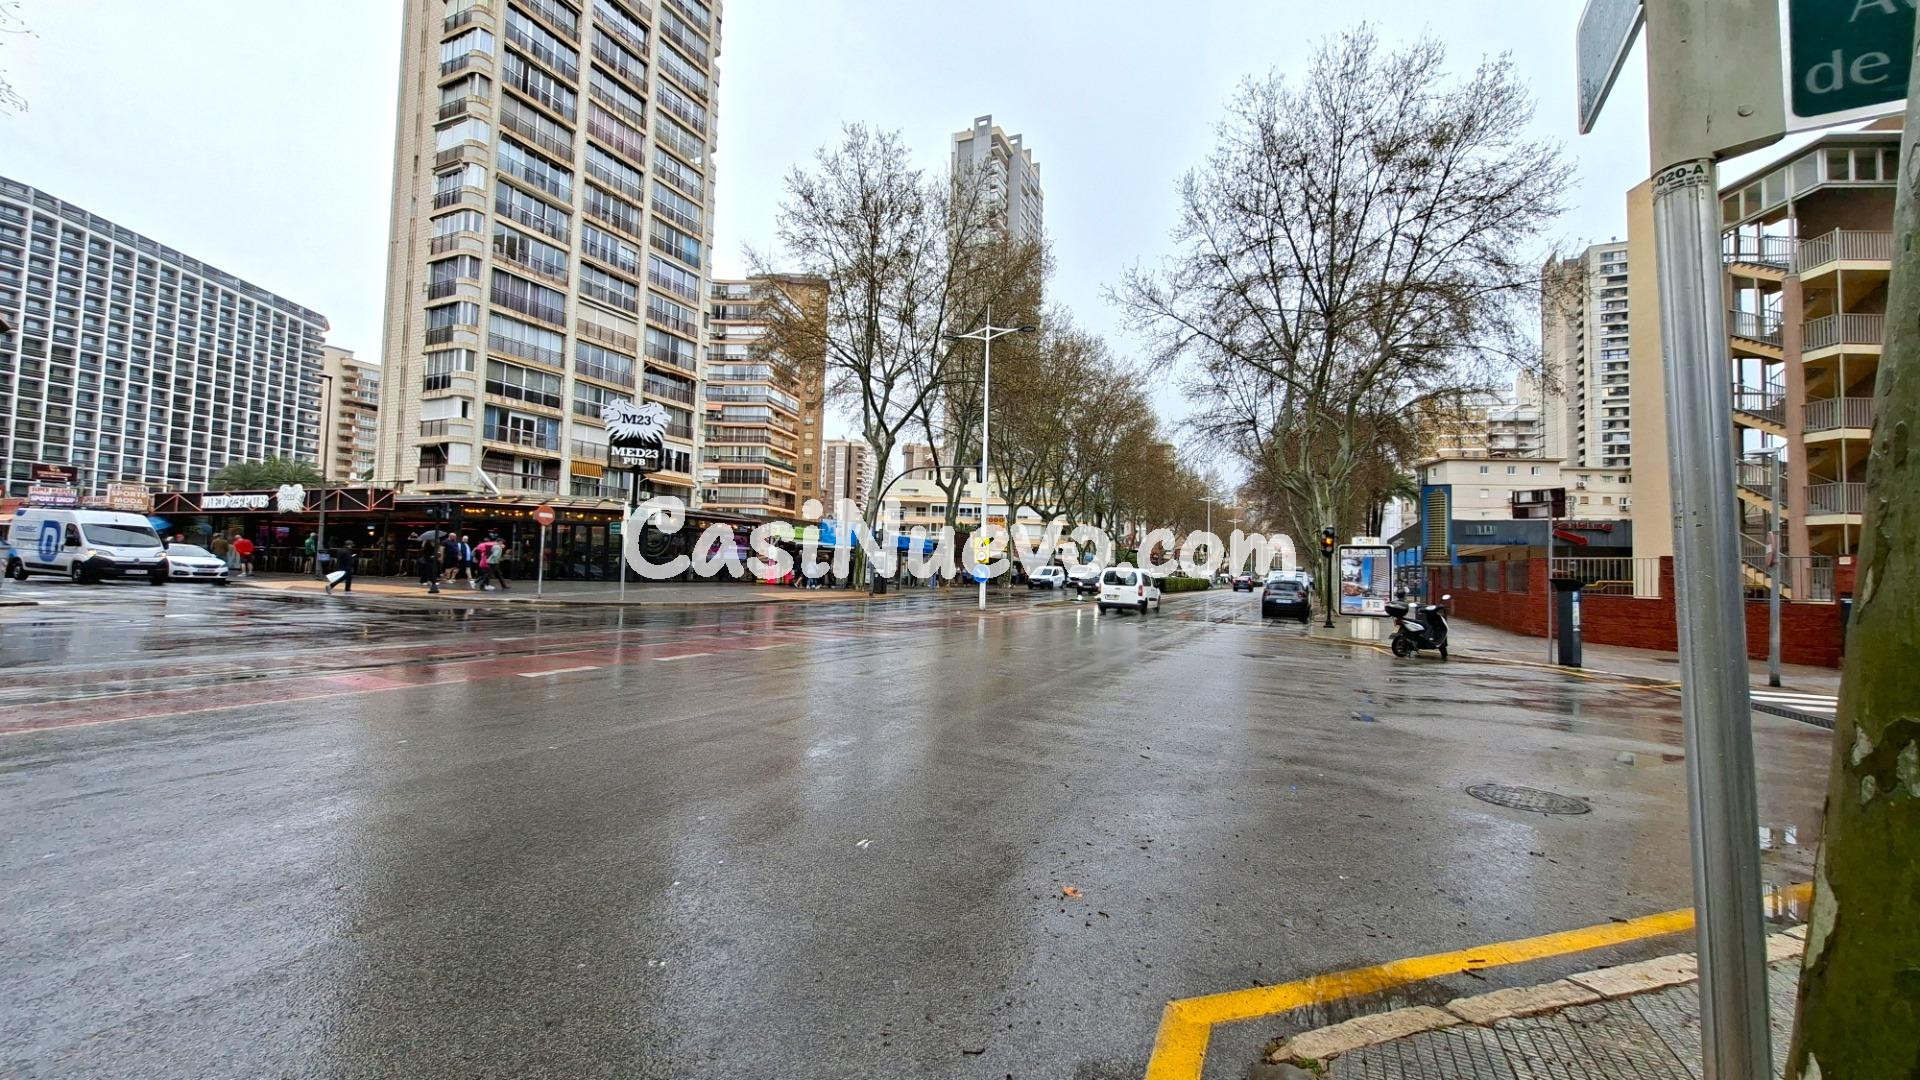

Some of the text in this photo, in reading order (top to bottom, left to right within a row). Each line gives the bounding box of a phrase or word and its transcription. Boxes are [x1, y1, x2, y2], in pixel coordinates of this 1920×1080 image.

[1805, 49, 1891, 94] de
[621, 413, 652, 426] M23
[611, 446, 659, 459] MED23
[623, 457, 646, 466] PUB
